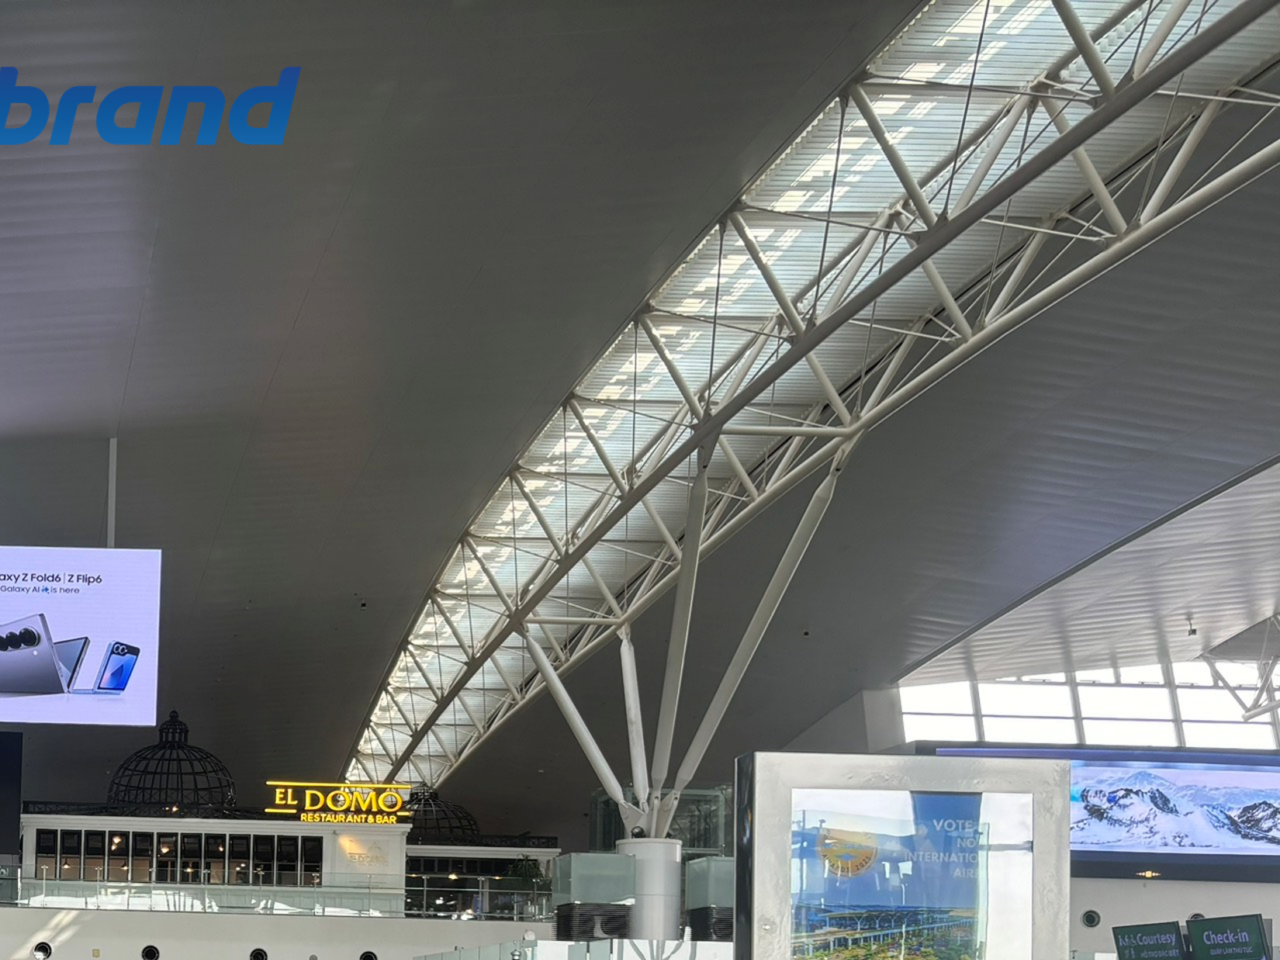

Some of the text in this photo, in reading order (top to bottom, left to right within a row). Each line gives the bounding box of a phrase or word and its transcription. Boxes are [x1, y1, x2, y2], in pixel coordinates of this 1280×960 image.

[22, 573, 28, 582] Z
[30, 572, 61, 583] Fold6
[67, 574, 74, 583] Z
[76, 573, 103, 586] Flip6
[0, 585, 30, 594] Galaxy
[59, 586, 80, 594] here
[275, 788, 403, 812] EL DOMO
[301, 813, 397, 824] RESTAURANT & BAR
[933, 819, 974, 832] VOTE
[957, 837, 977, 848] NO
[904, 851, 978, 863] INTERNATIO
[1137, 932, 1176, 946] Courtesy
[1203, 929, 1249, 945] Check-in
